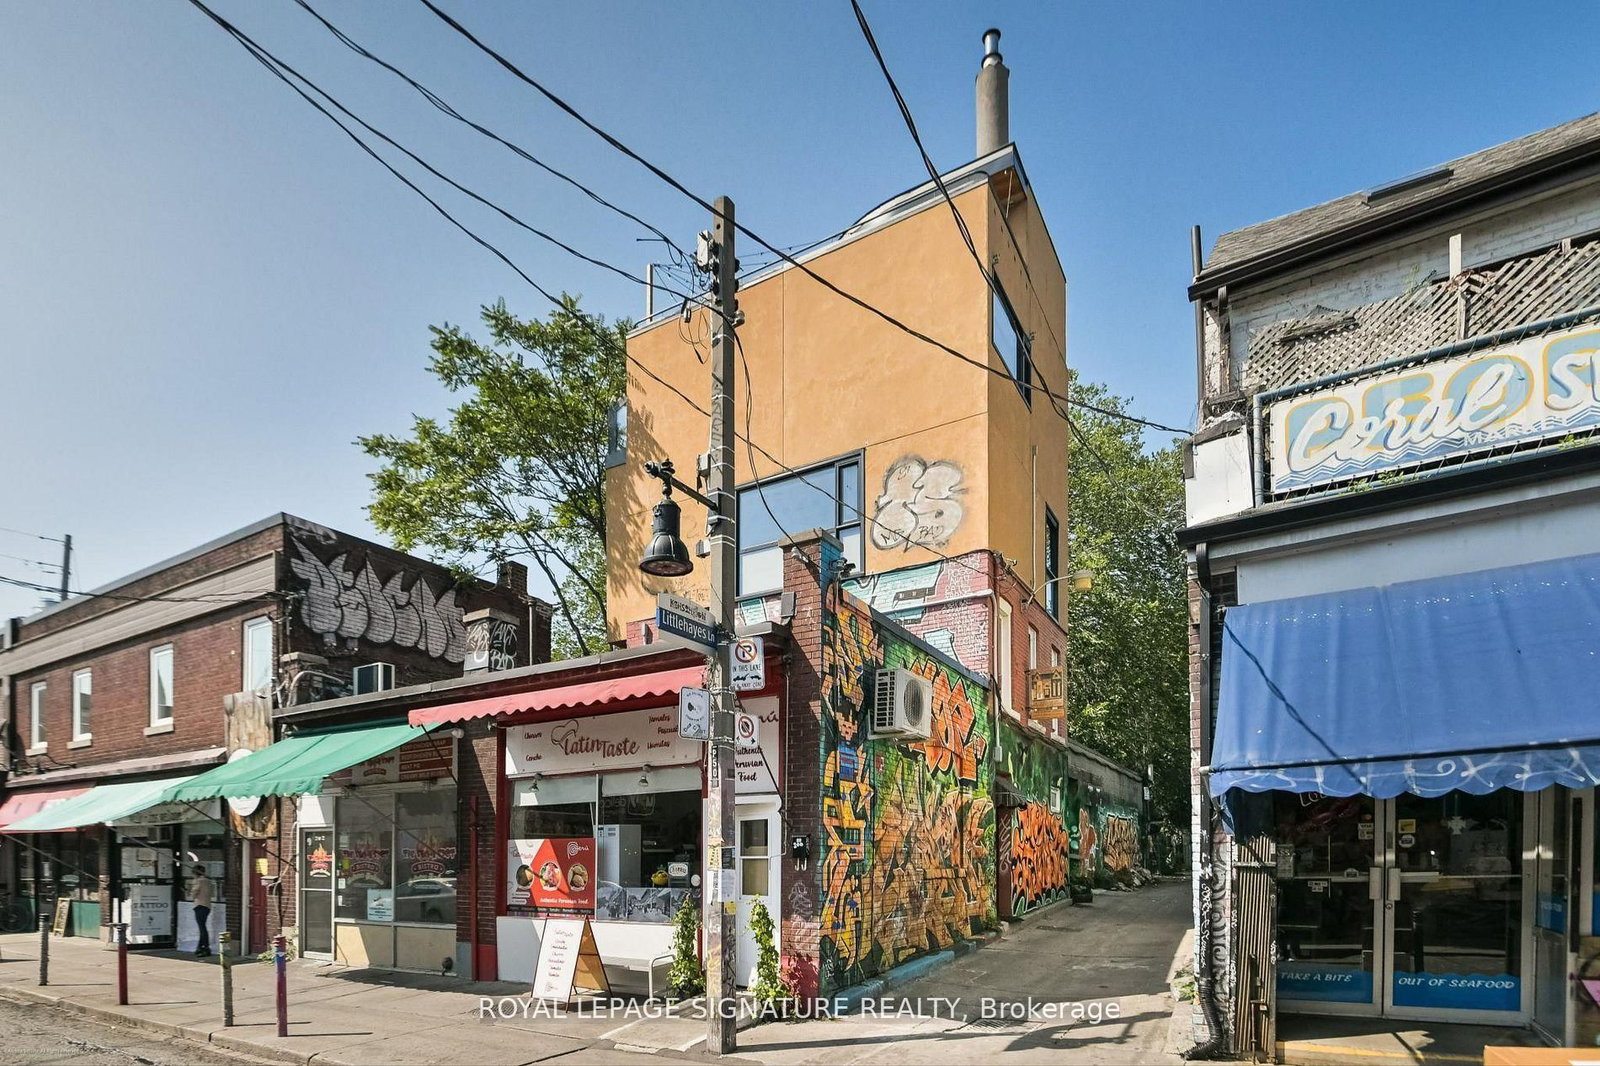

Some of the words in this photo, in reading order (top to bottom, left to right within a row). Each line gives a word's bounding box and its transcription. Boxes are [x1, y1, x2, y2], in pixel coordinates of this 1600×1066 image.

[1288, 363, 1515, 472] Coral
[662, 609, 707, 639] Littlehayes
[707, 629, 715, 643] Ln
[601, 736, 640, 759] Taste
[735, 760, 764, 769] eruvian
[737, 771, 758, 782] Food
[1280, 971, 1310, 980] TAKE
[1313, 972, 1322, 981] A
[1325, 973, 1353, 983] BITE
[1398, 976, 1425, 986] OUT
[1428, 977, 1448, 988] OF
[1449, 978, 1516, 990] SEAFOOD
